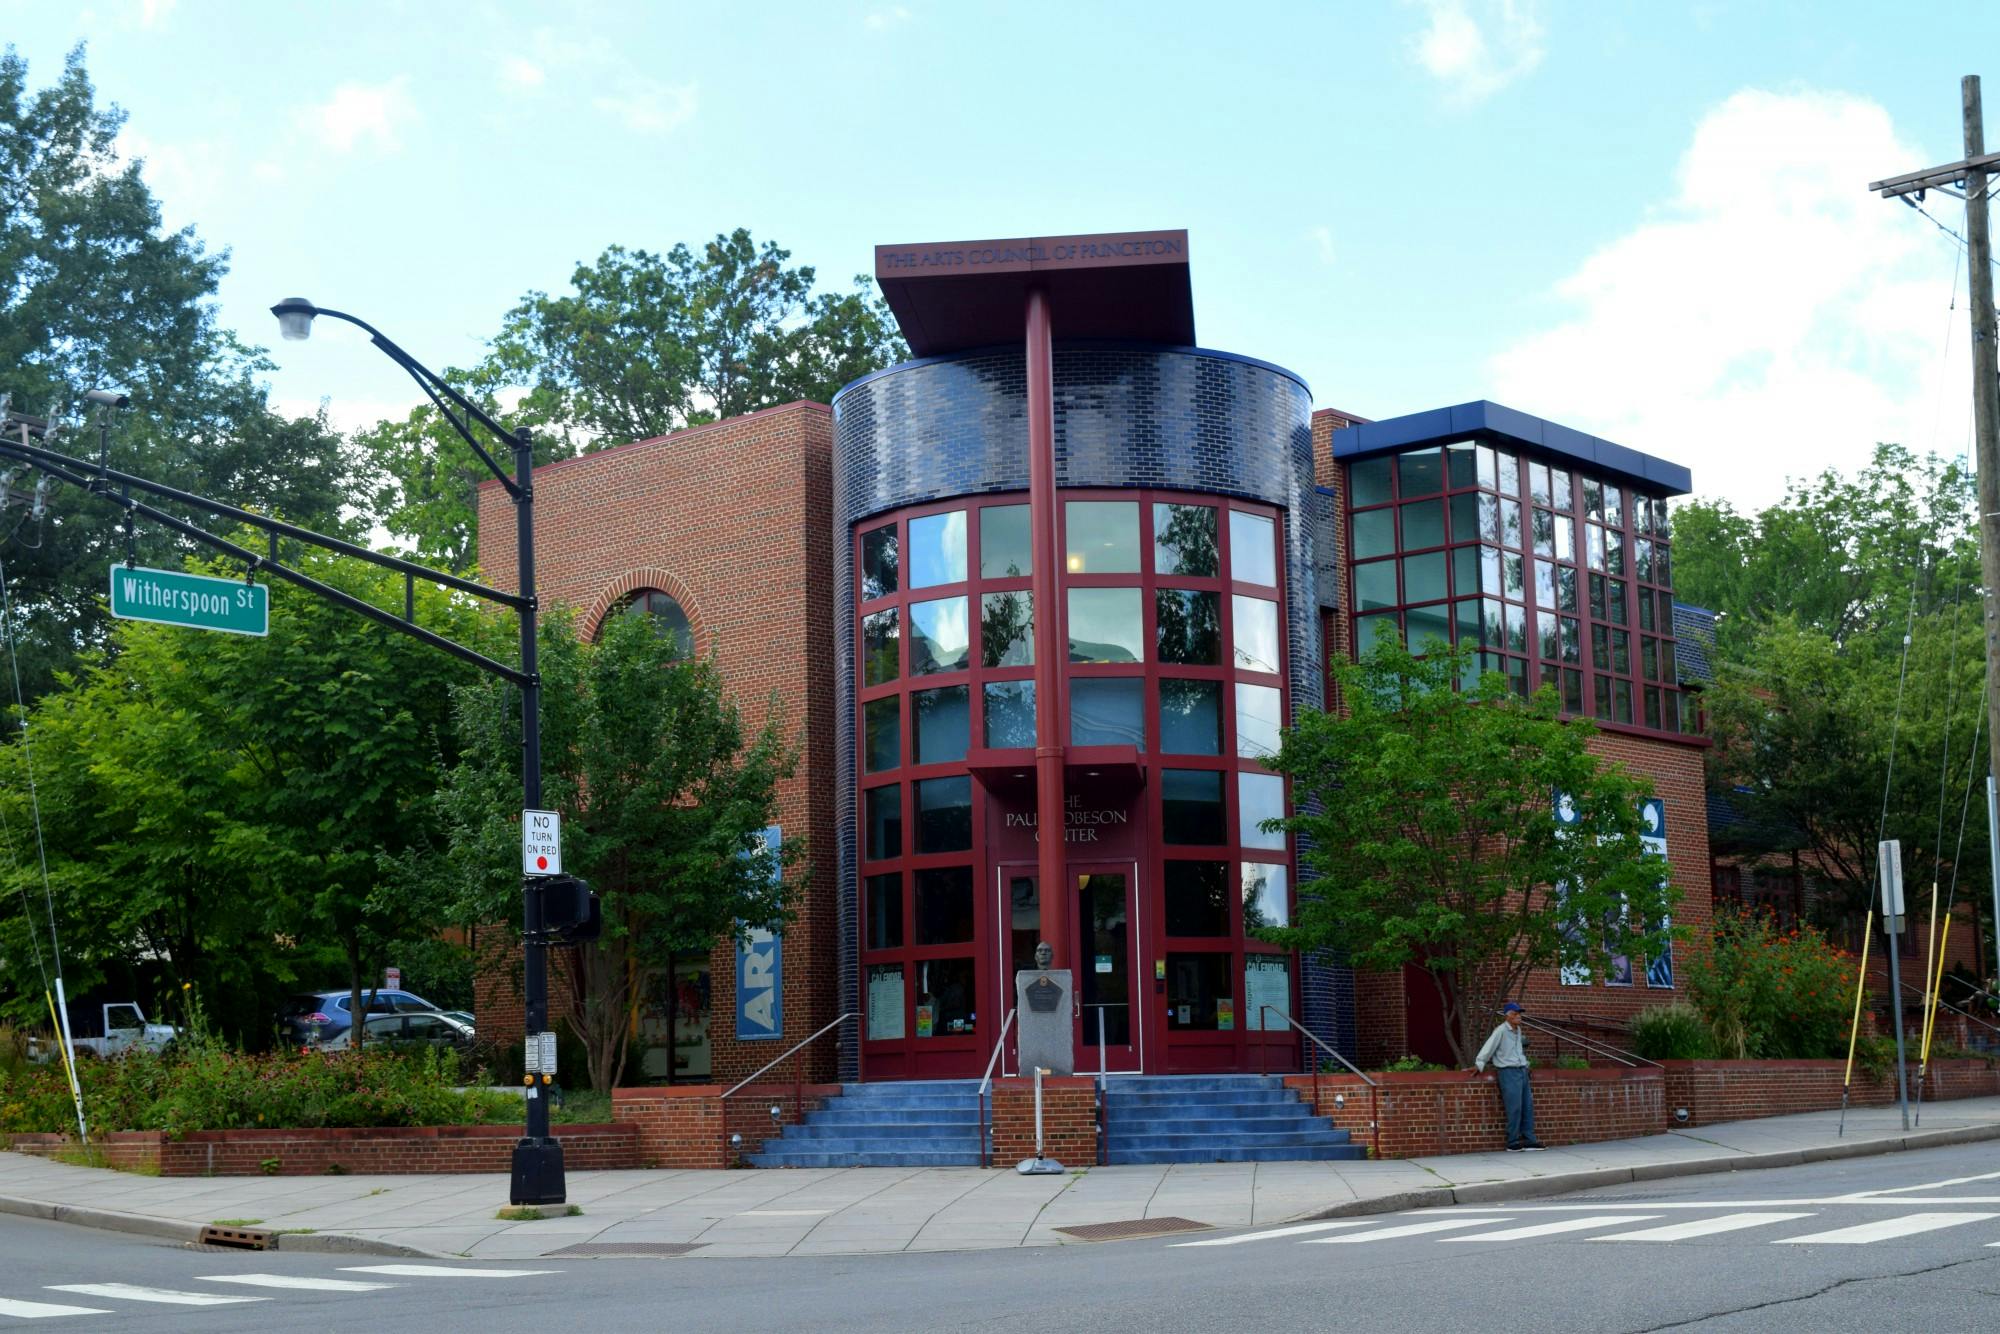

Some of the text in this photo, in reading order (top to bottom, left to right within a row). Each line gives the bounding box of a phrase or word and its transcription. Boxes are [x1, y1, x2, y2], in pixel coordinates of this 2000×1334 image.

[884, 239, 1183, 269] THE ARTS COUNCIL OF PRINCETON
[123, 577, 254, 616] Witherspoon St
[1064, 795, 1081, 808] HE
[534, 816, 549, 828] NO
[1006, 810, 1127, 827] PAU OBESON
[532, 832, 552, 841] TURN
[527, 844, 556, 854] ON RED
[1246, 961, 1285, 973] CALENDAR
